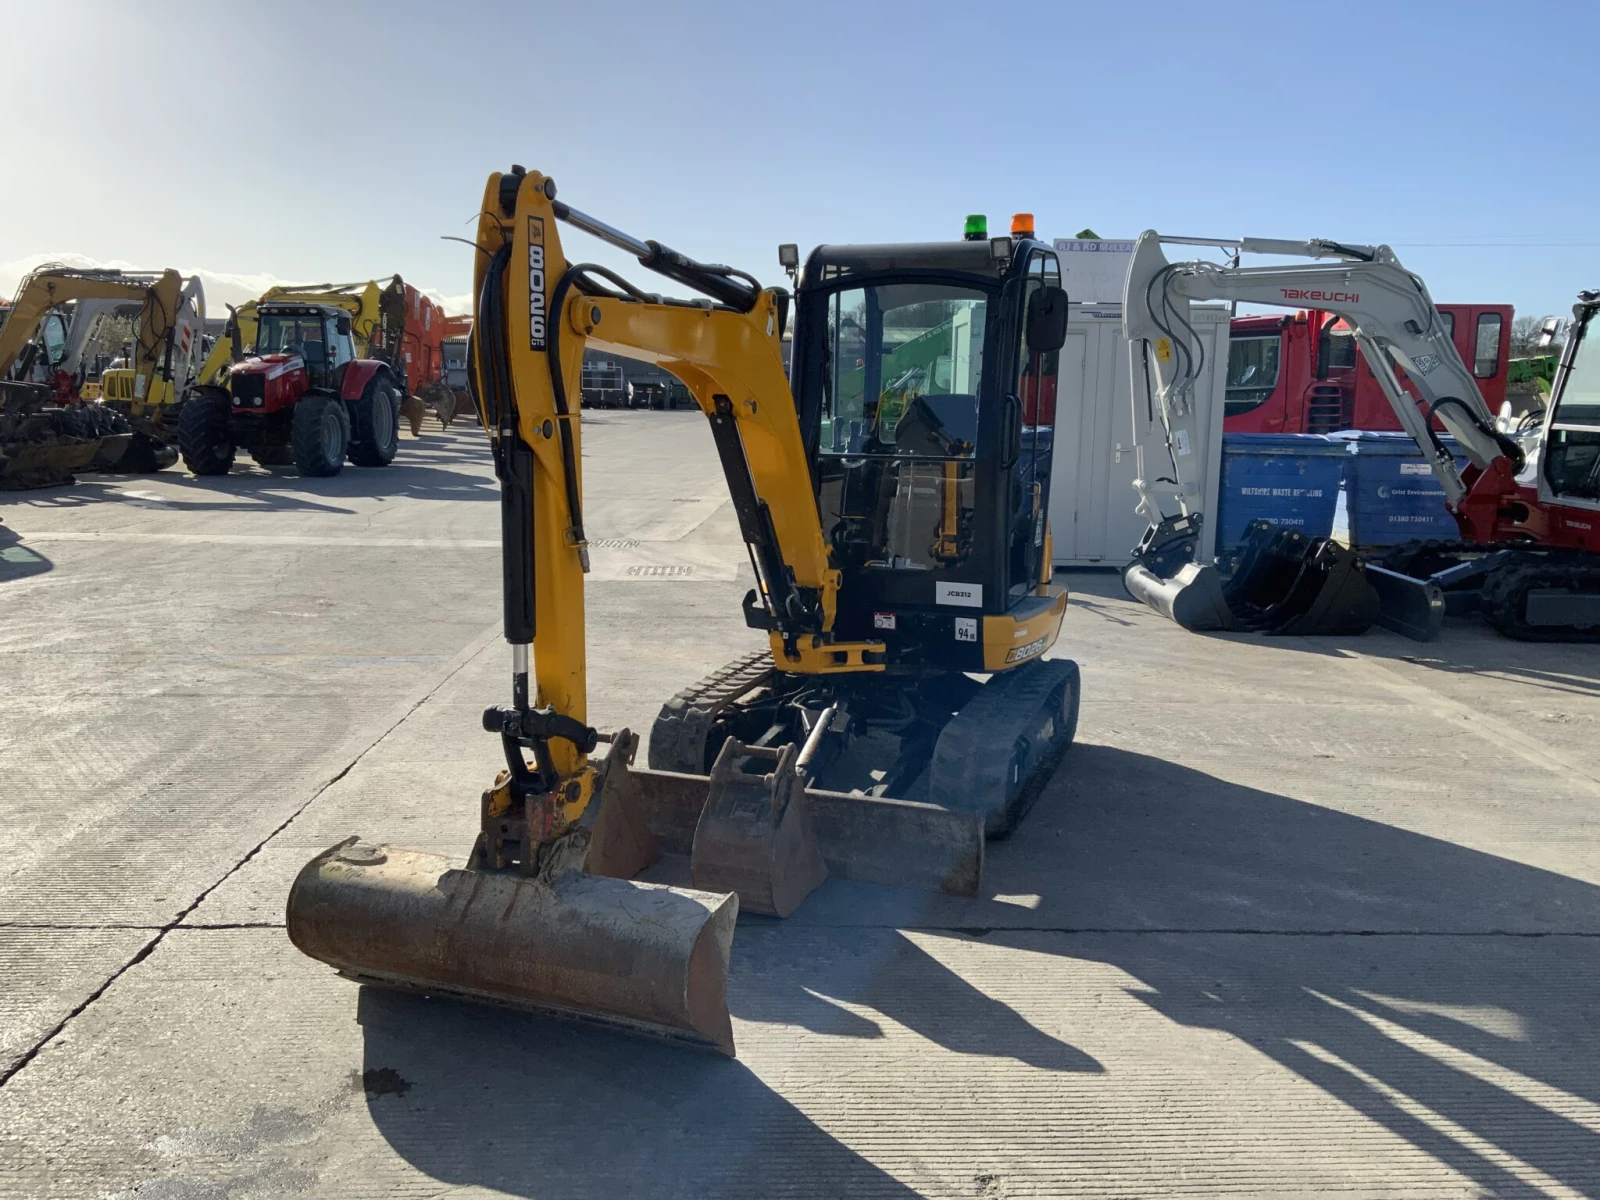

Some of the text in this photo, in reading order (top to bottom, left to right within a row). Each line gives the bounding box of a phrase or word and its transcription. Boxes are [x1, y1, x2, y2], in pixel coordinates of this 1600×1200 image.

[1058, 242, 1134, 252] RJ & KD McLEA
[529, 245, 545, 338] 8026
[1280, 288, 1360, 303] TAKEUCHI
[531, 338, 545, 346] CTS
[1272, 488, 1291, 497] WASTE
[1293, 488, 1323, 498] RELING
[1410, 515, 1434, 523] 730411
[947, 590, 972, 598] JCB312
[958, 627, 969, 639] 94
[1014, 639, 1043, 661] 8026
